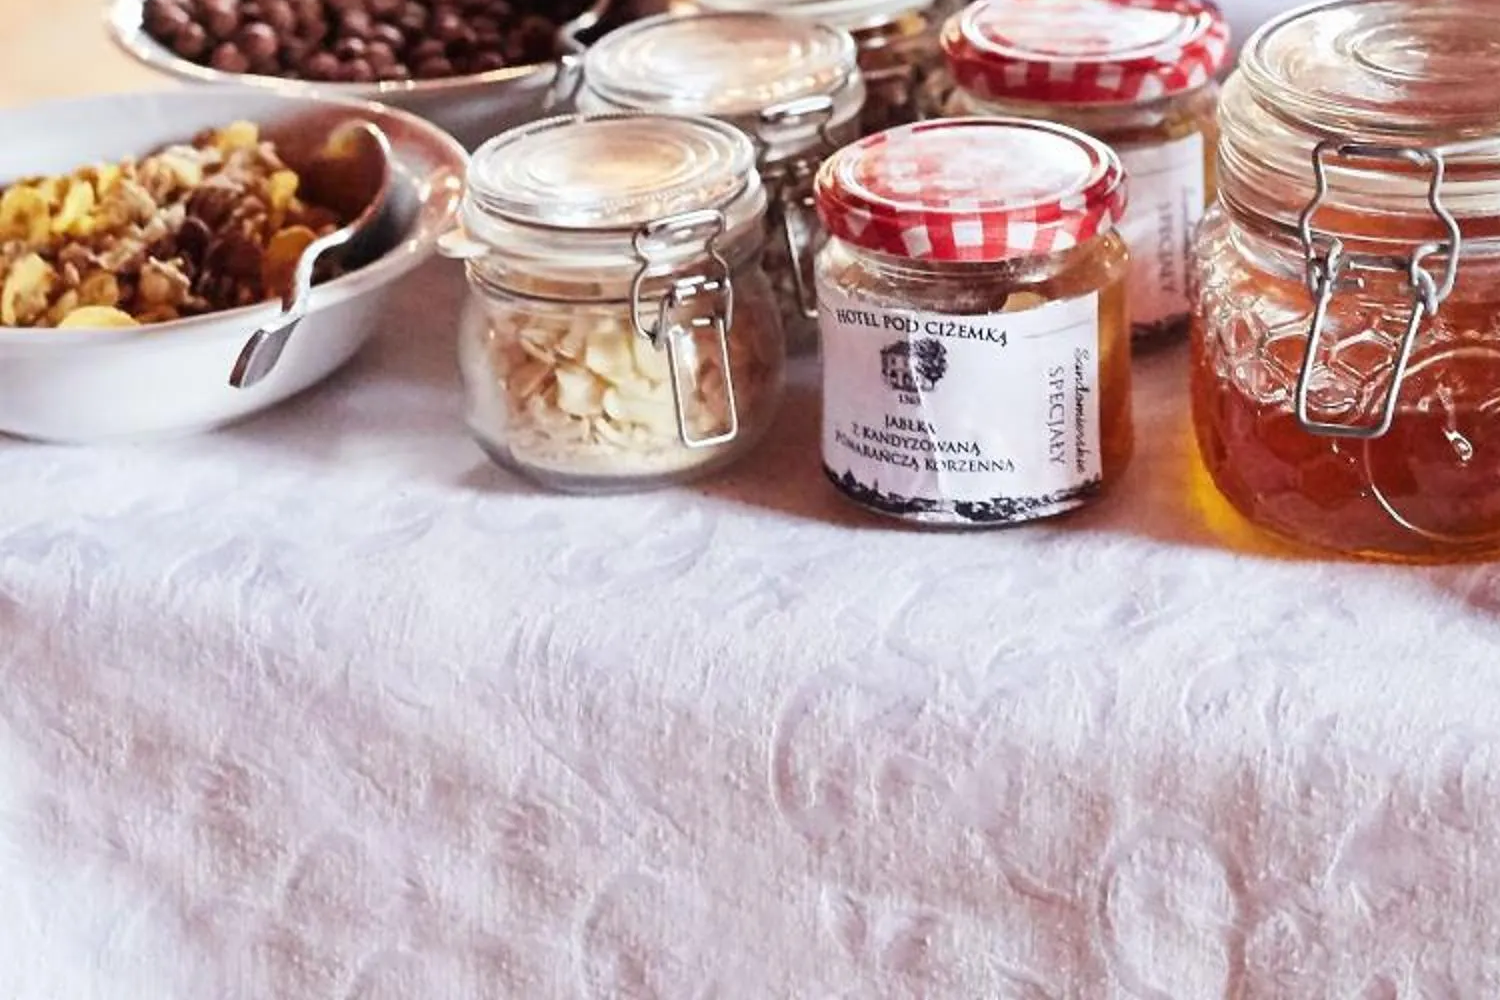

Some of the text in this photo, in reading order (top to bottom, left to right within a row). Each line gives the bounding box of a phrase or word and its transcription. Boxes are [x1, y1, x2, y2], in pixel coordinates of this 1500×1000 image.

[836, 309, 1008, 346] HOTEL POD CIŻEMKĄ
